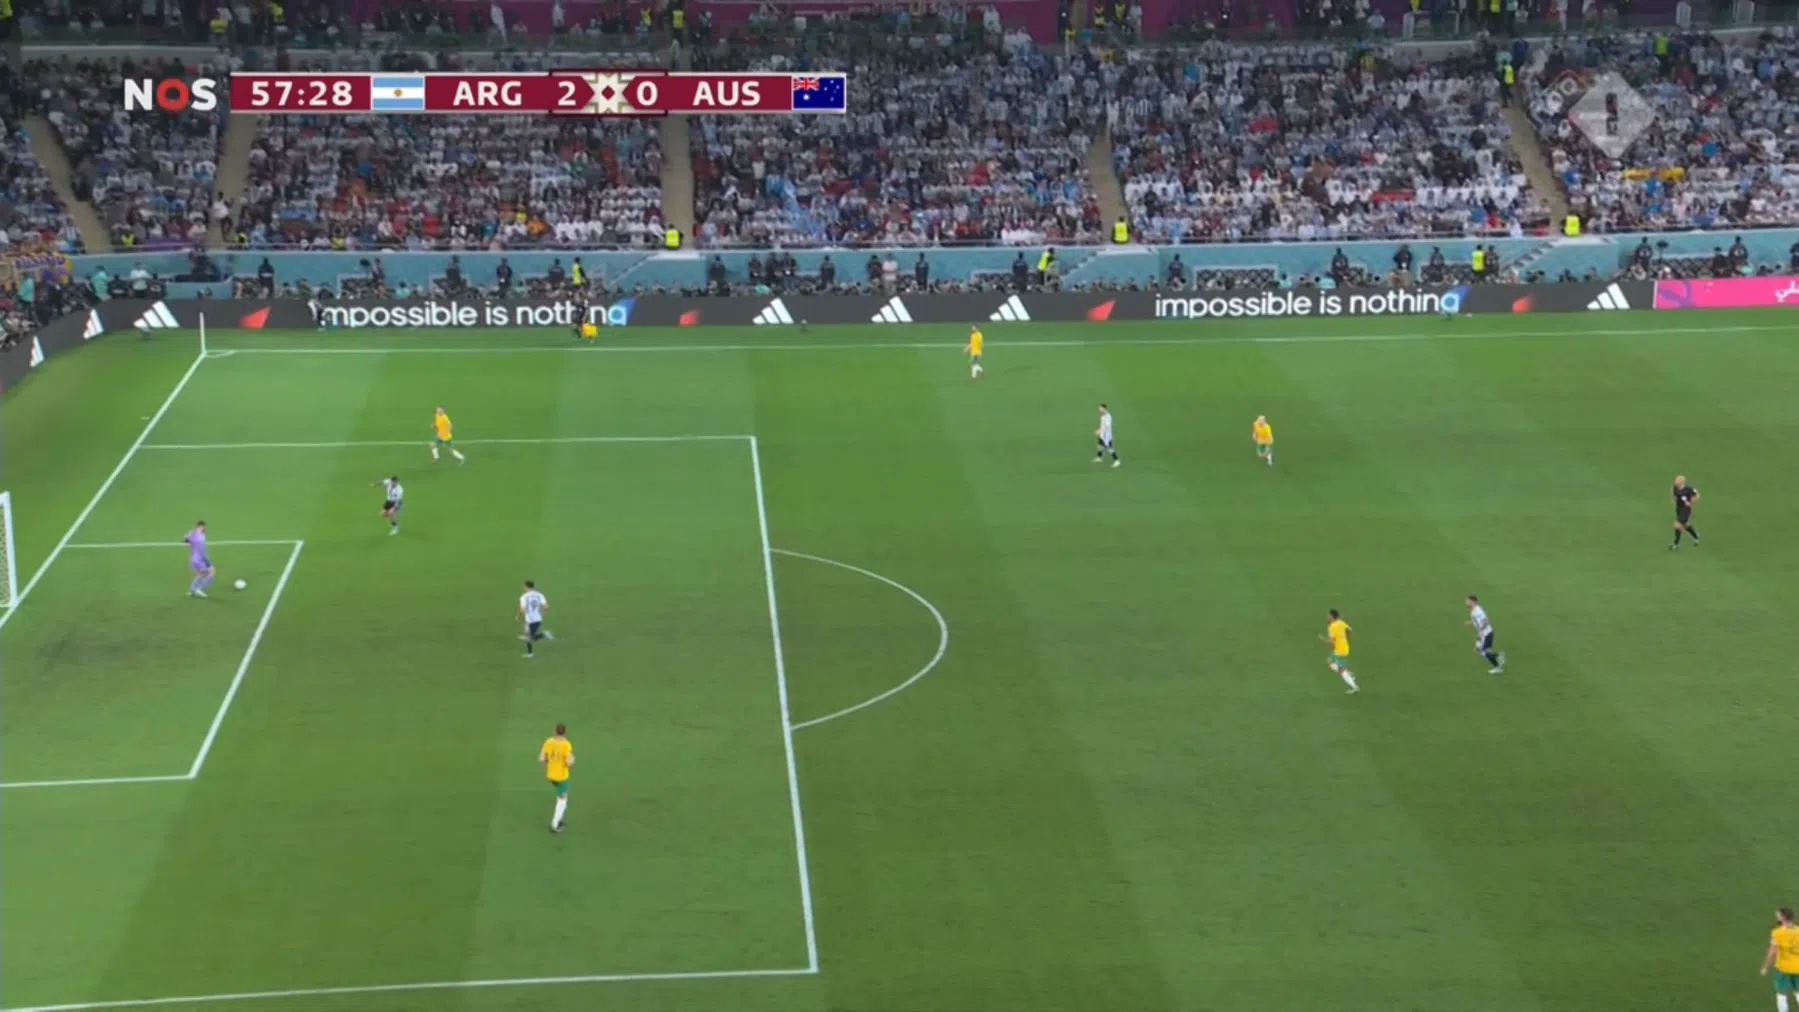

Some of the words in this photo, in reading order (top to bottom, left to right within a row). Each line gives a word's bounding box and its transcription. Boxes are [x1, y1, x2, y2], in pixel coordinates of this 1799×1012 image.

[320, 301, 478, 328] mpossible
[485, 301, 509, 325] is
[516, 300, 627, 326] nothng
[1154, 290, 1312, 319] impossible
[1319, 290, 1343, 315] is
